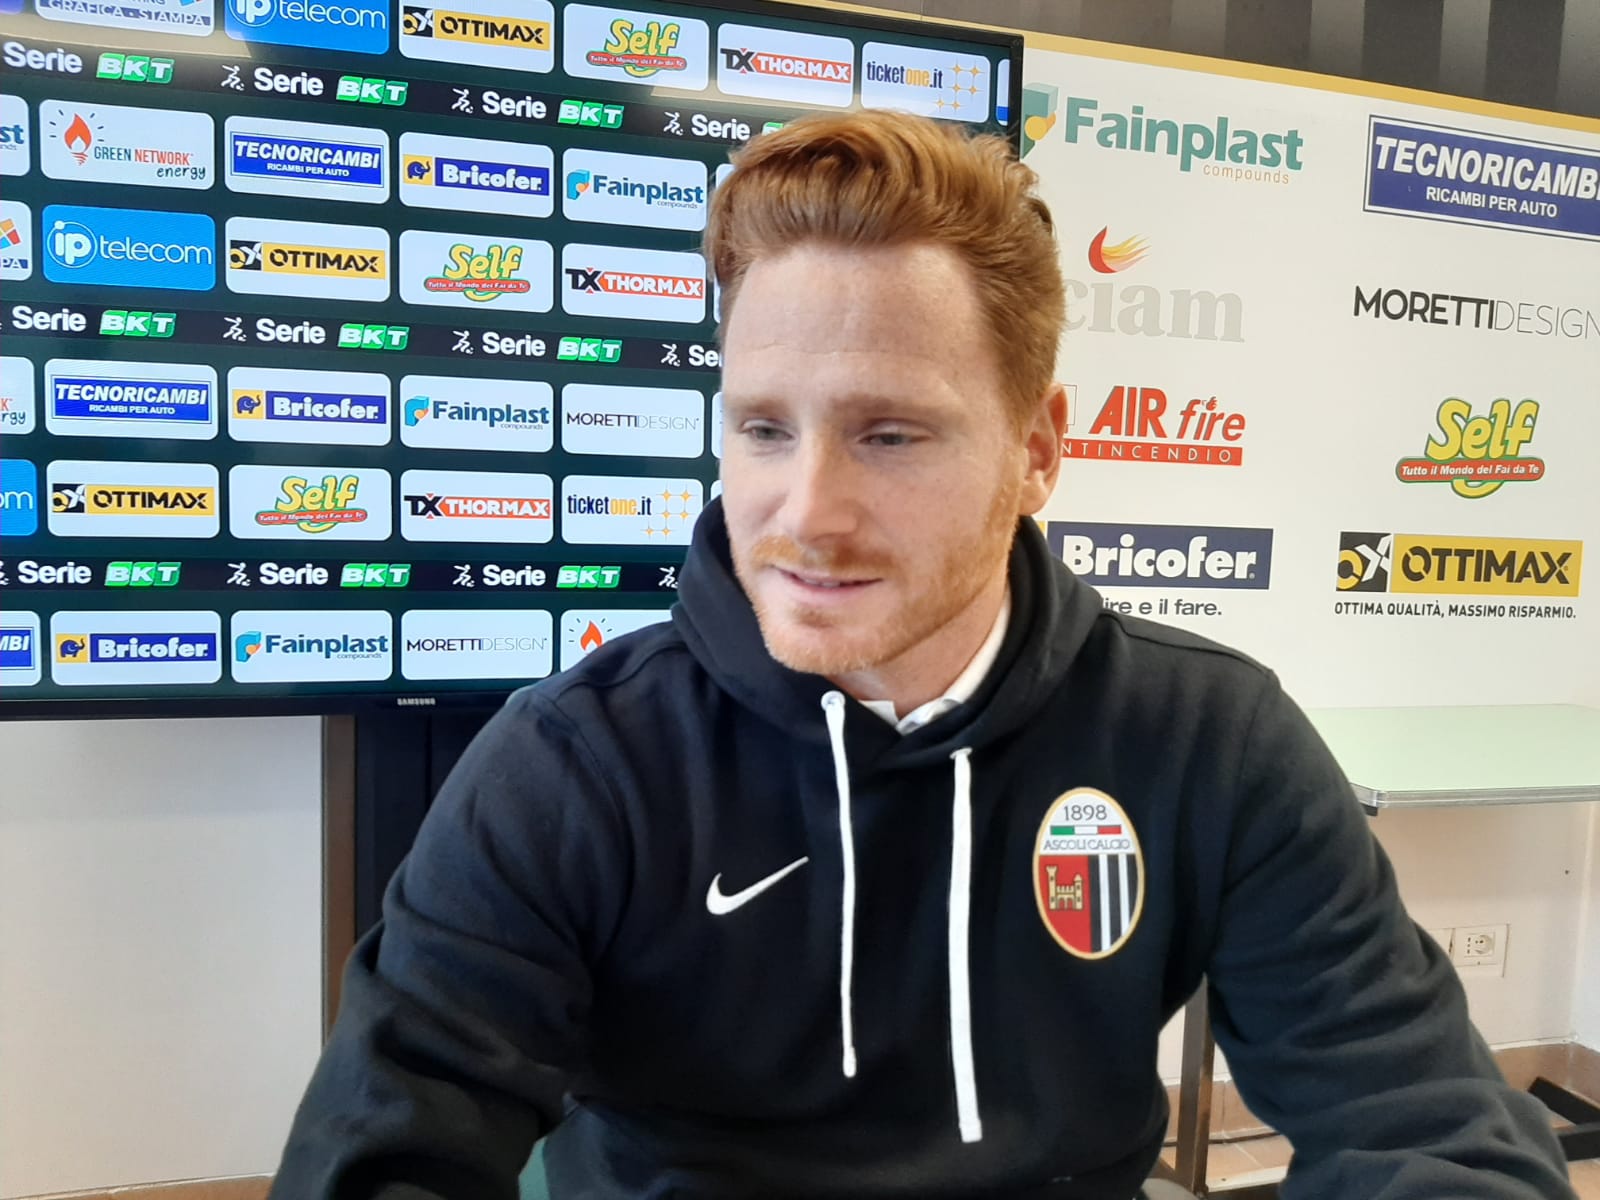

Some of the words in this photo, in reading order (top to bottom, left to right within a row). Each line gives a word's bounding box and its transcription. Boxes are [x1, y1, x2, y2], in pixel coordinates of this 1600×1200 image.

[139, 10, 205, 26] STAMPA
[278, 0, 386, 29] telecom
[441, 16, 545, 44] OTTIMAX
[604, 18, 680, 56] Self
[3, 42, 83, 74] Serie
[96, 53, 175, 84] BKT
[756, 55, 850, 82] THORMAX
[866, 60, 943, 89] ticketone.it
[253, 67, 325, 97] Serie
[336, 76, 408, 106] BKT
[482, 90, 547, 120] Serie
[558, 100, 625, 129] BKT
[691, 113, 751, 141] Serie
[1065, 96, 1304, 172] Fainplast
[94, 147, 131, 162] GREEN
[134, 148, 190, 166] NETWORK
[234, 140, 380, 169] TECNORICAMBI
[157, 164, 206, 180] energy
[266, 162, 304, 174] RICAMBI
[305, 166, 324, 175] PER
[325, 167, 350, 177] AUTO
[1203, 163, 1290, 185] compounds
[593, 174, 704, 205] Fainplast
[1426, 186, 1486, 208] RICAMBI
[1489, 195, 1517, 212] PER
[1519, 200, 1558, 218] AUTO
[657, 199, 698, 209] compounds
[100, 234, 212, 265] telecom
[269, 248, 379, 273] OTTIMAX
[443, 243, 523, 280] Self
[603, 273, 702, 297] THORMAX
[12, 304, 87, 333] Serie
[99, 309, 177, 338] BKT
[255, 318, 326, 345] Serie
[337, 323, 410, 351] BKT
[482, 331, 546, 357] Serie
[556, 336, 622, 363] BKT
[55, 383, 208, 406] TECNORICAMBI
[89, 404, 128, 415] RICAMBI
[129, 405, 149, 414] PER
[150, 406, 175, 415] AUTO
[433, 400, 550, 428] Fainplast
[1089, 385, 1168, 439] AIR
[1176, 397, 1246, 442] fire
[501, 422, 543, 430] compounds
[1424, 398, 1540, 461] Self
[1061, 442, 1232, 463] NTINCENDIO
[1402, 465, 1428, 476] Tutto
[1431, 465, 1437, 475] il
[1440, 464, 1474, 475] Mondo
[1477, 464, 1492, 475] del
[1495, 464, 1510, 474] Fai
[1513, 464, 1525, 474] da
[1528, 463, 1540, 474] Te
[93, 489, 208, 510] OTTIMAX
[275, 475, 359, 512] Self
[567, 494, 652, 516] ticketone.it
[445, 497, 549, 518] THORMAX
[18, 560, 92, 585] Serie
[104, 561, 181, 586] BKT
[259, 562, 328, 585] Serie
[340, 563, 411, 587] BKT
[482, 564, 546, 587] Serie
[556, 565, 621, 589] BKT
[1401, 545, 1573, 585] OTTIMAX
[1139, 601, 1152, 615] e
[1159, 599, 1168, 615] il
[1174, 598, 1222, 616] fare.
[1335, 602, 1384, 616] OTTIMA
[1387, 599, 1445, 618] QUALITÀ,
[1449, 604, 1505, 618] MASSIMO
[1508, 605, 1577, 619] RISPARMIO.
[265, 634, 388, 659] Fainplast
[1063, 804, 1108, 821] 1898
[1043, 839, 1086, 851] ASCOLI
[1087, 838, 1131, 850] CALCIO
